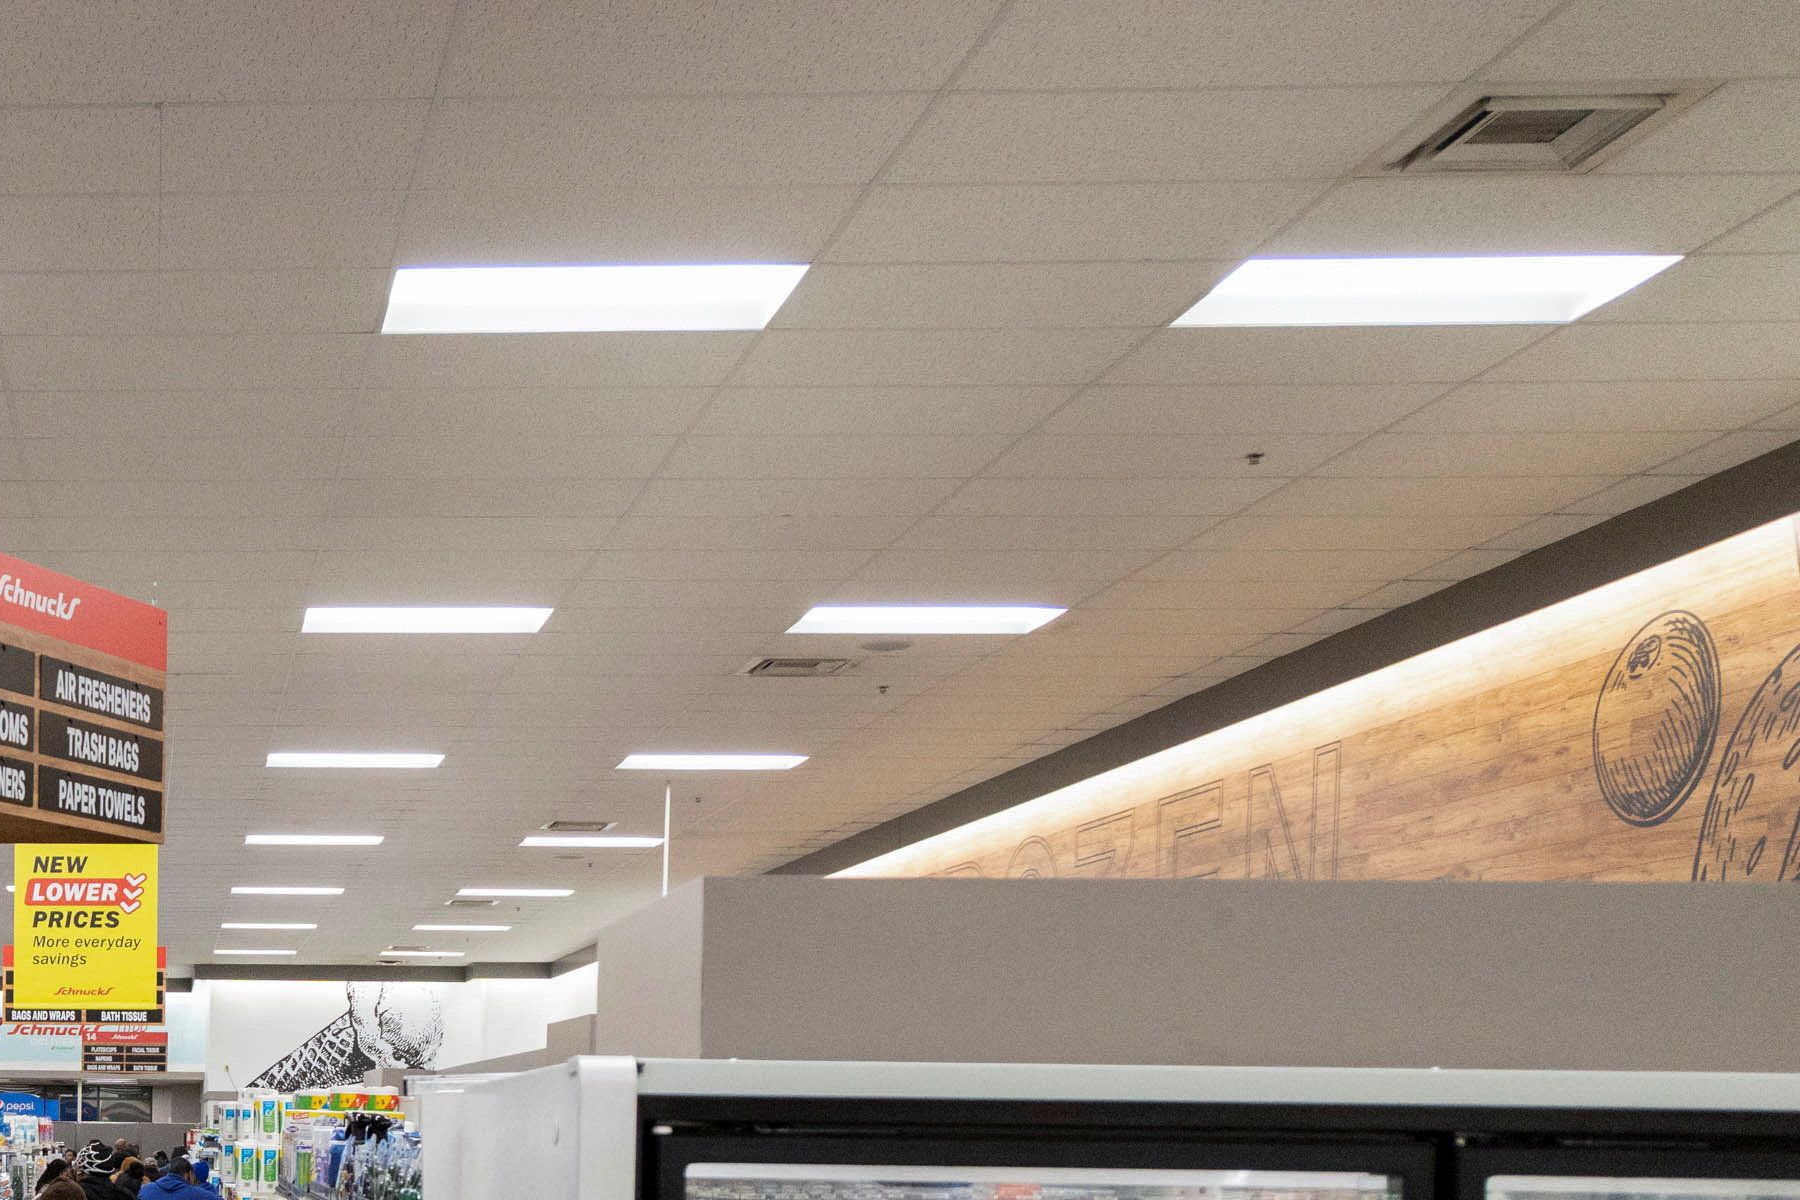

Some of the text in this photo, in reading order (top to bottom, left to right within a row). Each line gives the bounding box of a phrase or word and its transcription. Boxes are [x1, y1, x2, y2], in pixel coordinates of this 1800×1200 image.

[55, 669, 151, 724] AIR FRESHENERS
[67, 726, 139, 772] TRASH BAGS
[59, 779, 145, 825] PAPER TOWELS
[33, 856, 88, 873] NEW
[32, 882, 118, 902] LOWER
[32, 911, 120, 928] PRICES
[33, 935, 141, 950] More everyday
[33, 953, 87, 967] savings
[53, 987, 115, 996] Schnucks
[12, 1011, 75, 1021] BAGS AND WRAPS
[101, 1012, 147, 1021] BATH TISSUE
[6, 1101, 35, 1111] pepsi
